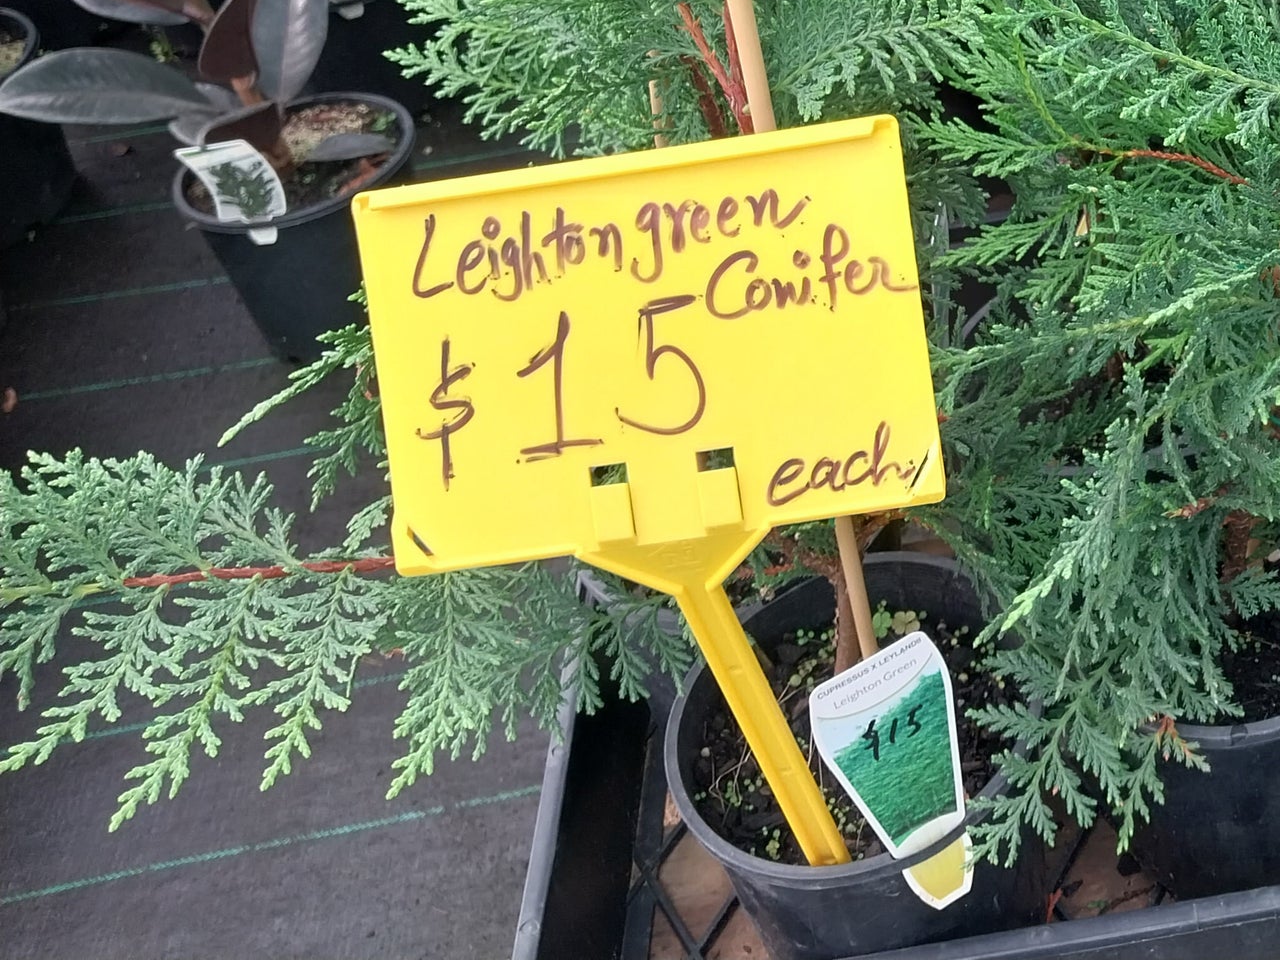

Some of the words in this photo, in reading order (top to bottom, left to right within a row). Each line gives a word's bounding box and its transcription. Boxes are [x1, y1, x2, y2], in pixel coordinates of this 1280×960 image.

[631, 187, 811, 283] green
[705, 223, 918, 320] Conifer
[816, 667, 870, 701] CUPRESSUS
[832, 678, 883, 711] Leighton
[882, 657, 918, 683] Green
[861, 703, 924, 762] $15
